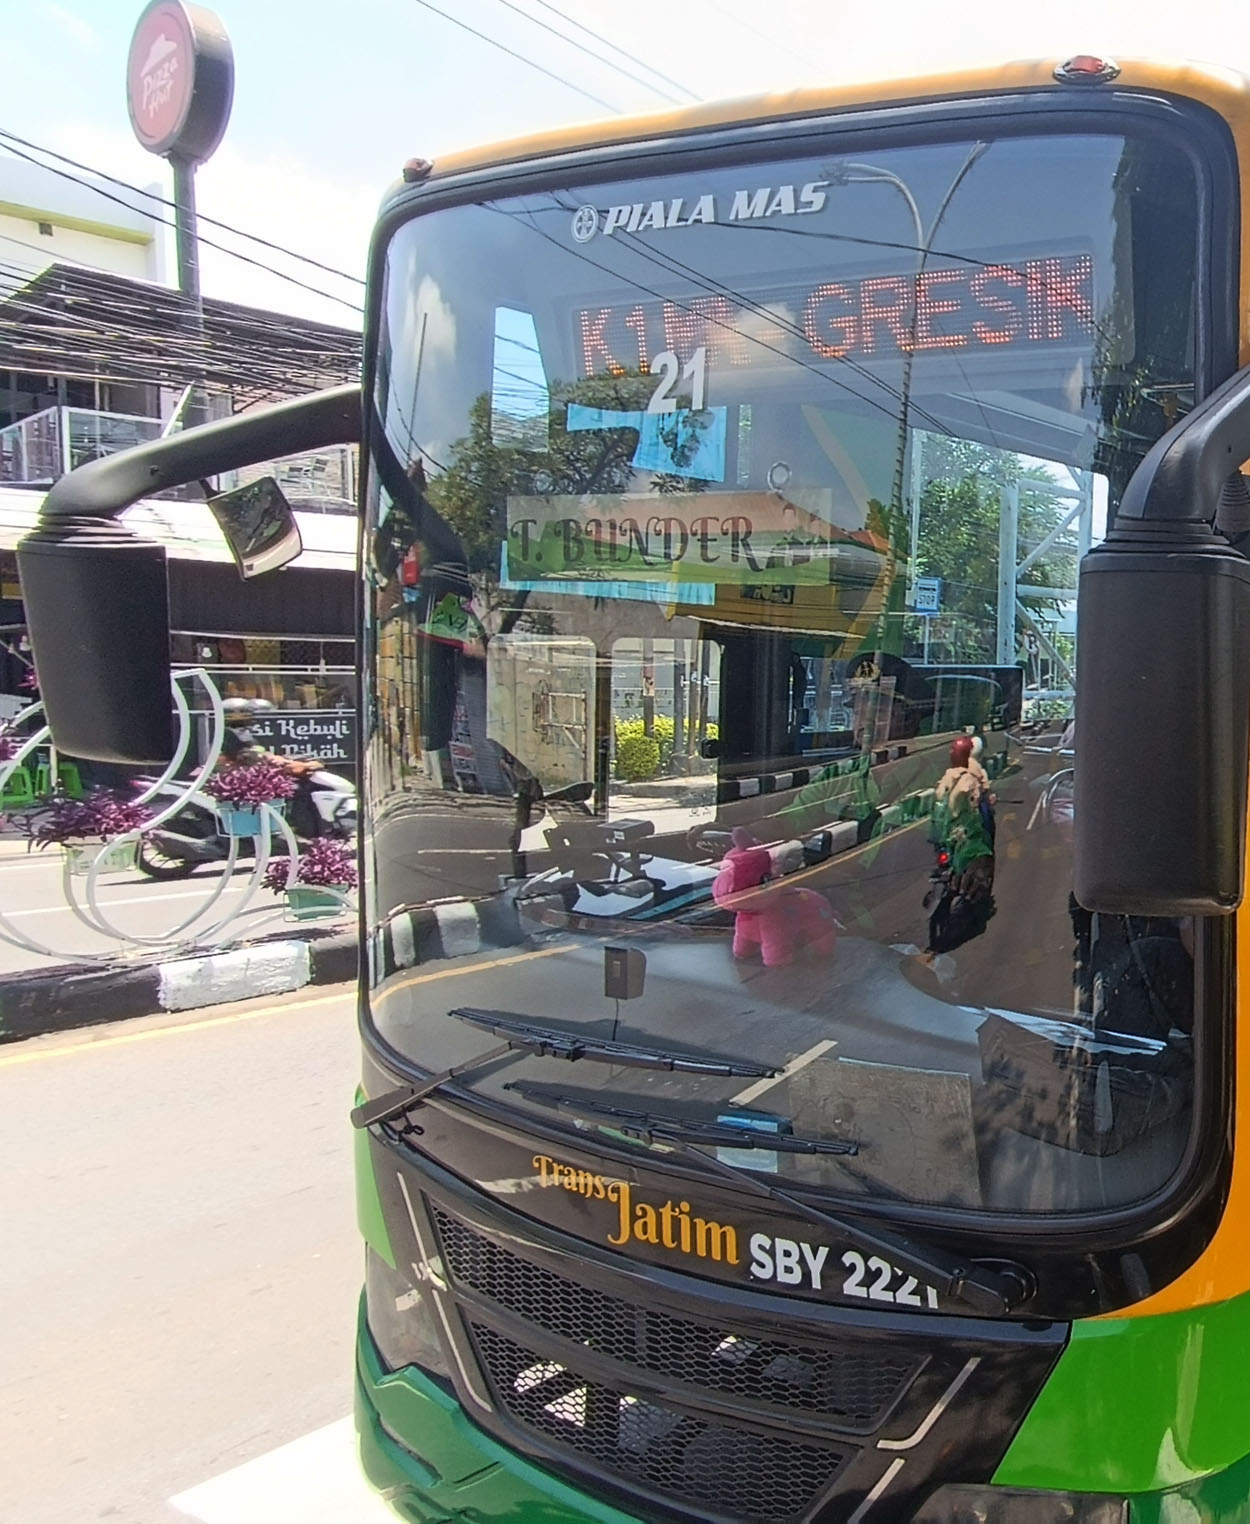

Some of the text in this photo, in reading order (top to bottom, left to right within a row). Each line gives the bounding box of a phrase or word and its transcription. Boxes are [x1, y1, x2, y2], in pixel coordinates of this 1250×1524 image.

[603, 181, 831, 235] PIALA MAS
[803, 255, 1092, 358] GRESIK
[648, 346, 706, 414] 21
[510, 516, 764, 572] T. BUNDER
[276, 719, 350, 740] Kebuli
[532, 1155, 606, 1199] Trans
[607, 1180, 740, 1265] Jatim
[749, 1232, 829, 1290] SBY
